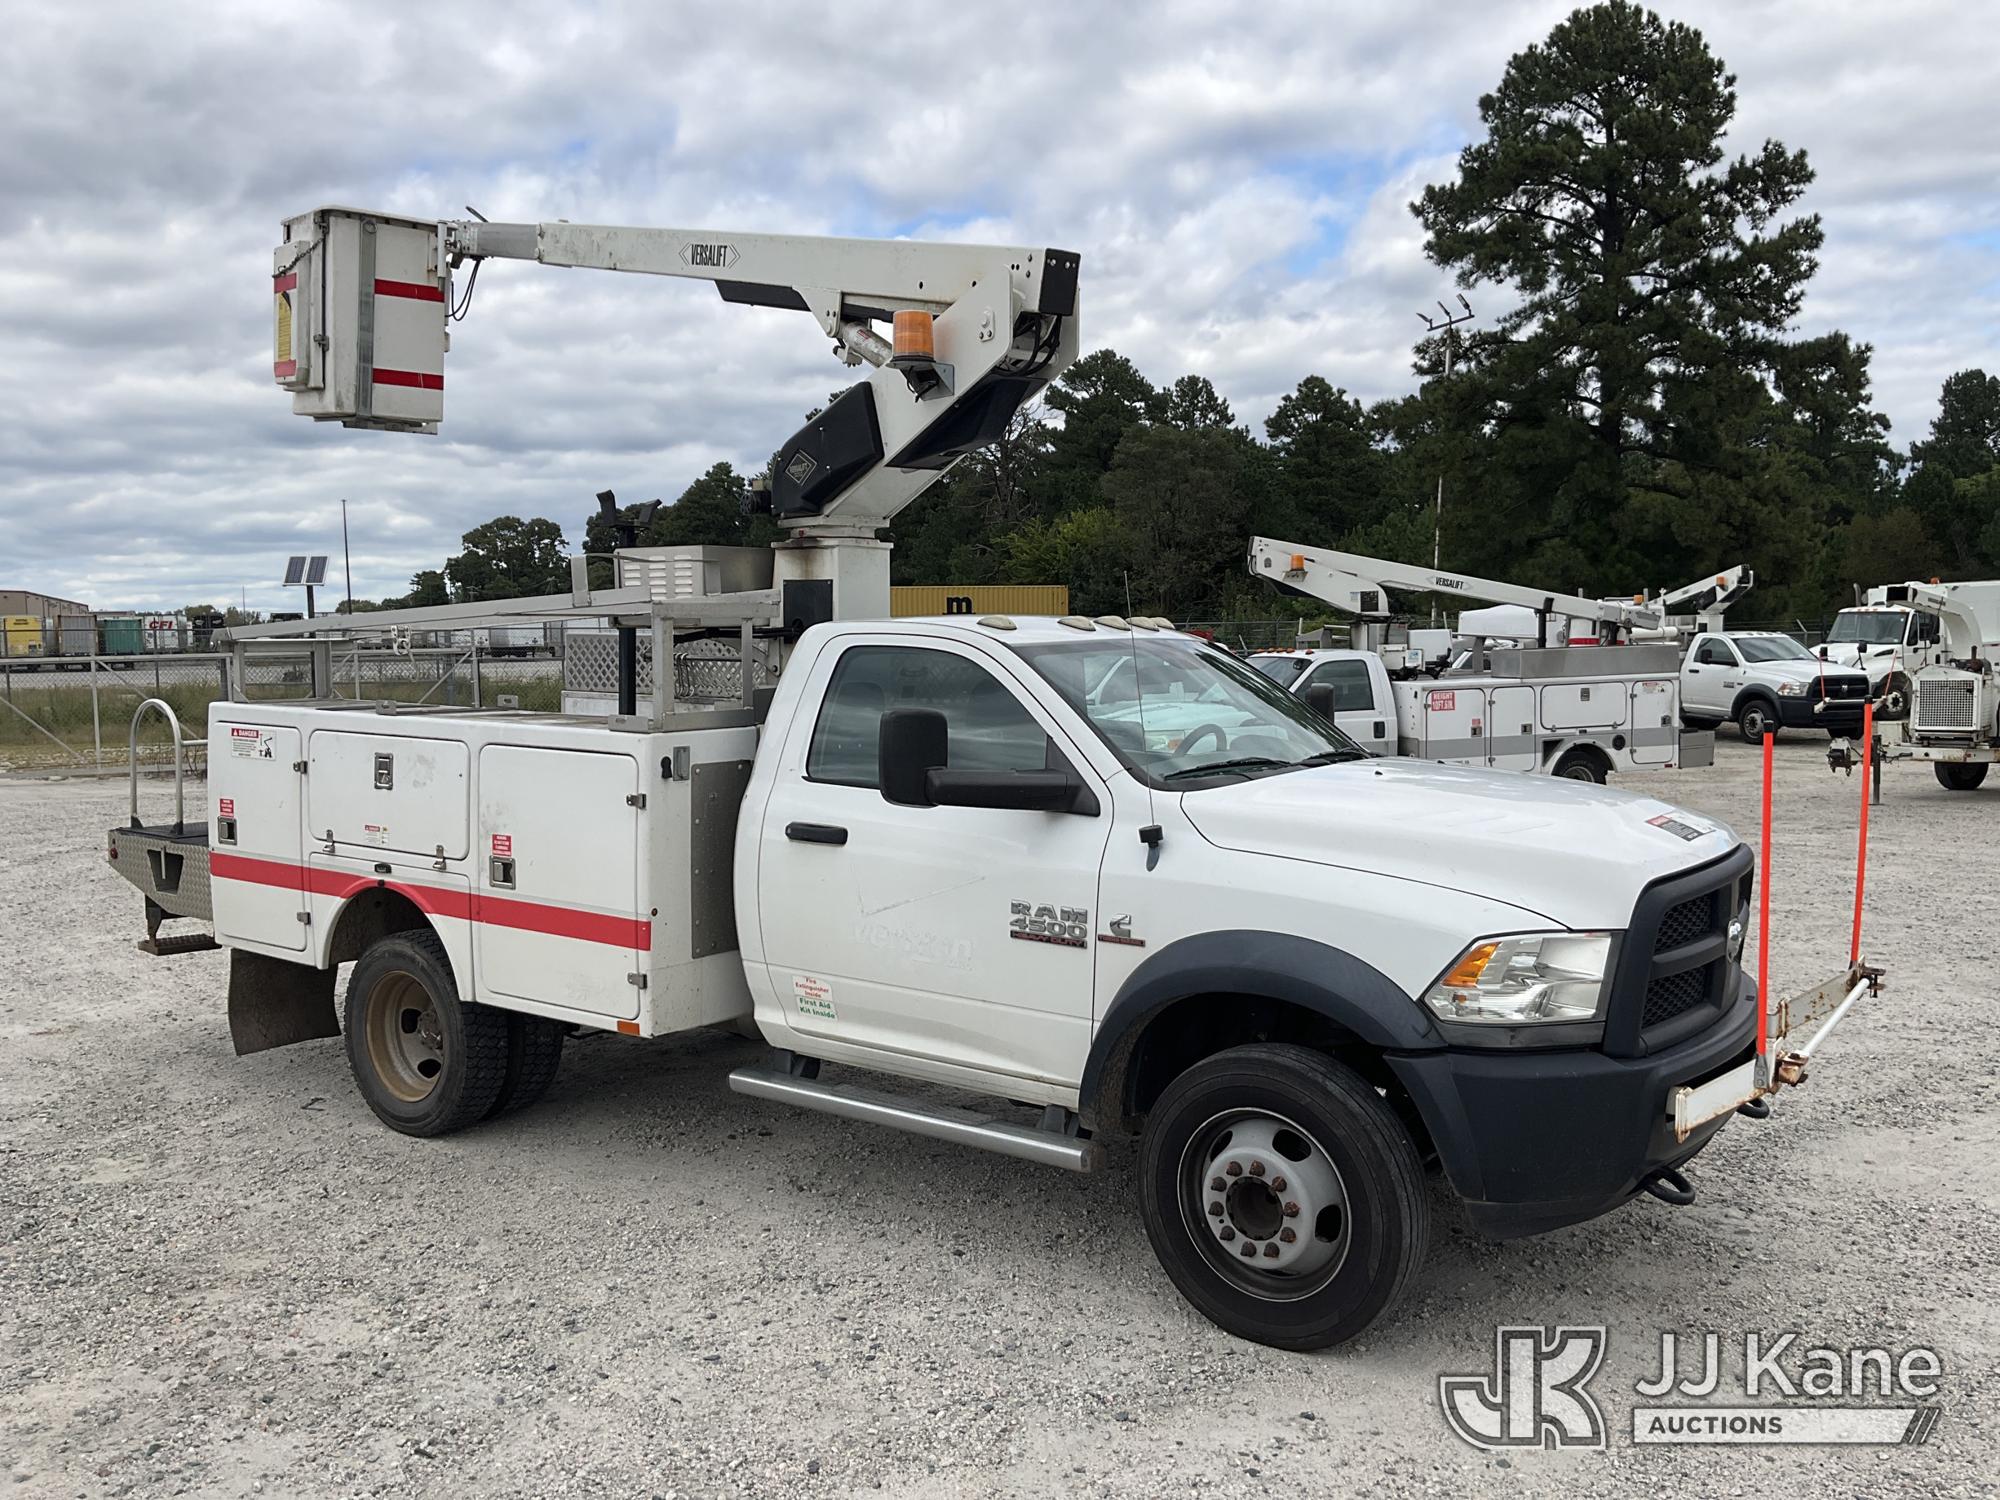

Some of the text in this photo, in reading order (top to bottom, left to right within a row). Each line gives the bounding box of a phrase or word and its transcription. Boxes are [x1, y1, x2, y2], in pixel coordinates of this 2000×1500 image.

[691, 244, 728, 267] VERSALIFT
[1435, 576, 1464, 590] VERSALIFT
[149, 620, 173, 630] CFI
[1010, 899, 1088, 923] RAM
[1009, 915, 1088, 939] 4500
[795, 982, 829, 993] Extinguisher
[799, 997, 831, 1010] First Aid
[799, 1006, 836, 1019] Kit Inside
